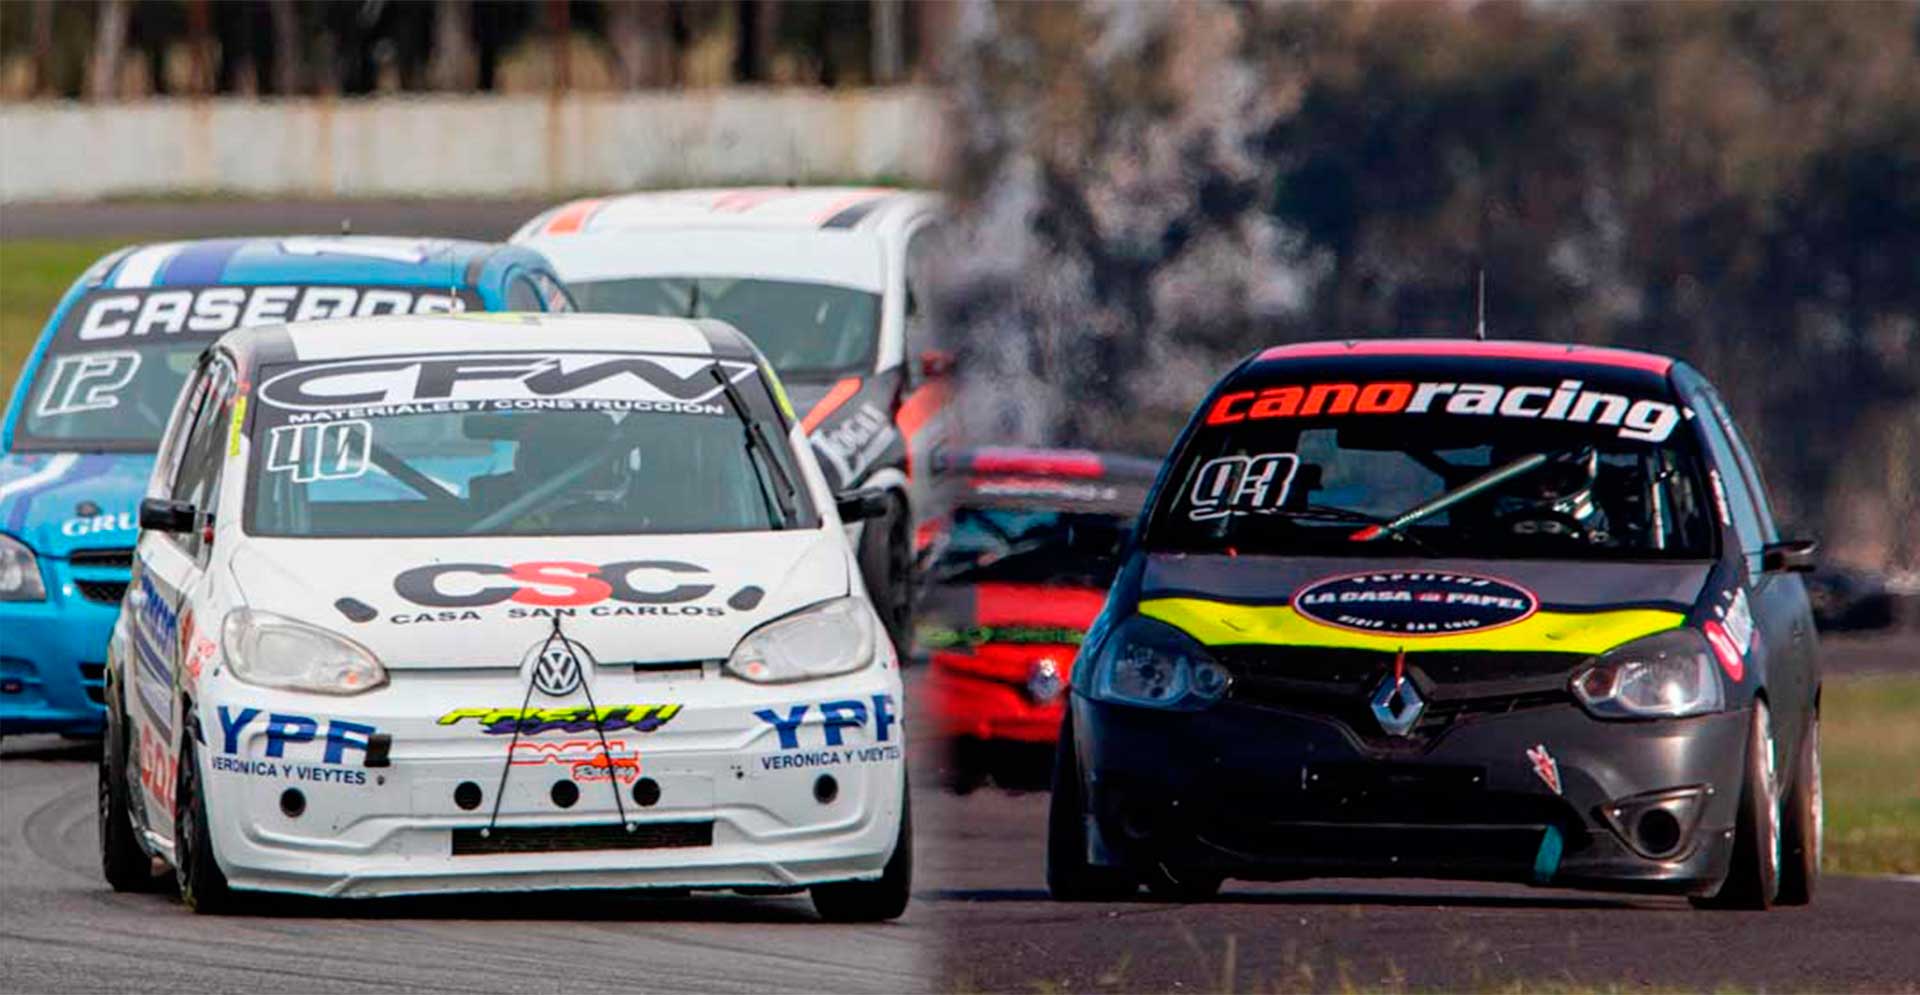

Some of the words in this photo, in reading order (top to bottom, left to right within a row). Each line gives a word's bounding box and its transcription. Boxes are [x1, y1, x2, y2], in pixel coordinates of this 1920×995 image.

[39, 351, 141, 416] 12
[288, 401, 470, 424] MATERIALES
[1207, 380, 1684, 443] canoracing
[267, 418, 372, 482] 40
[393, 560, 715, 608] CSC
[1340, 590, 1412, 602] CASA
[1446, 592, 1526, 610] PAPEL
[390, 610, 482, 625] CASA
[508, 607, 576, 618] SAN
[590, 605, 726, 617] CARLOS
[217, 705, 376, 764] YPF
[211, 757, 277, 777] VERONICA
[282, 765, 293, 778] Y
[297, 766, 367, 785] VIEYTES
[761, 752, 841, 770] VERONICA
[844, 749, 853, 764] Y
